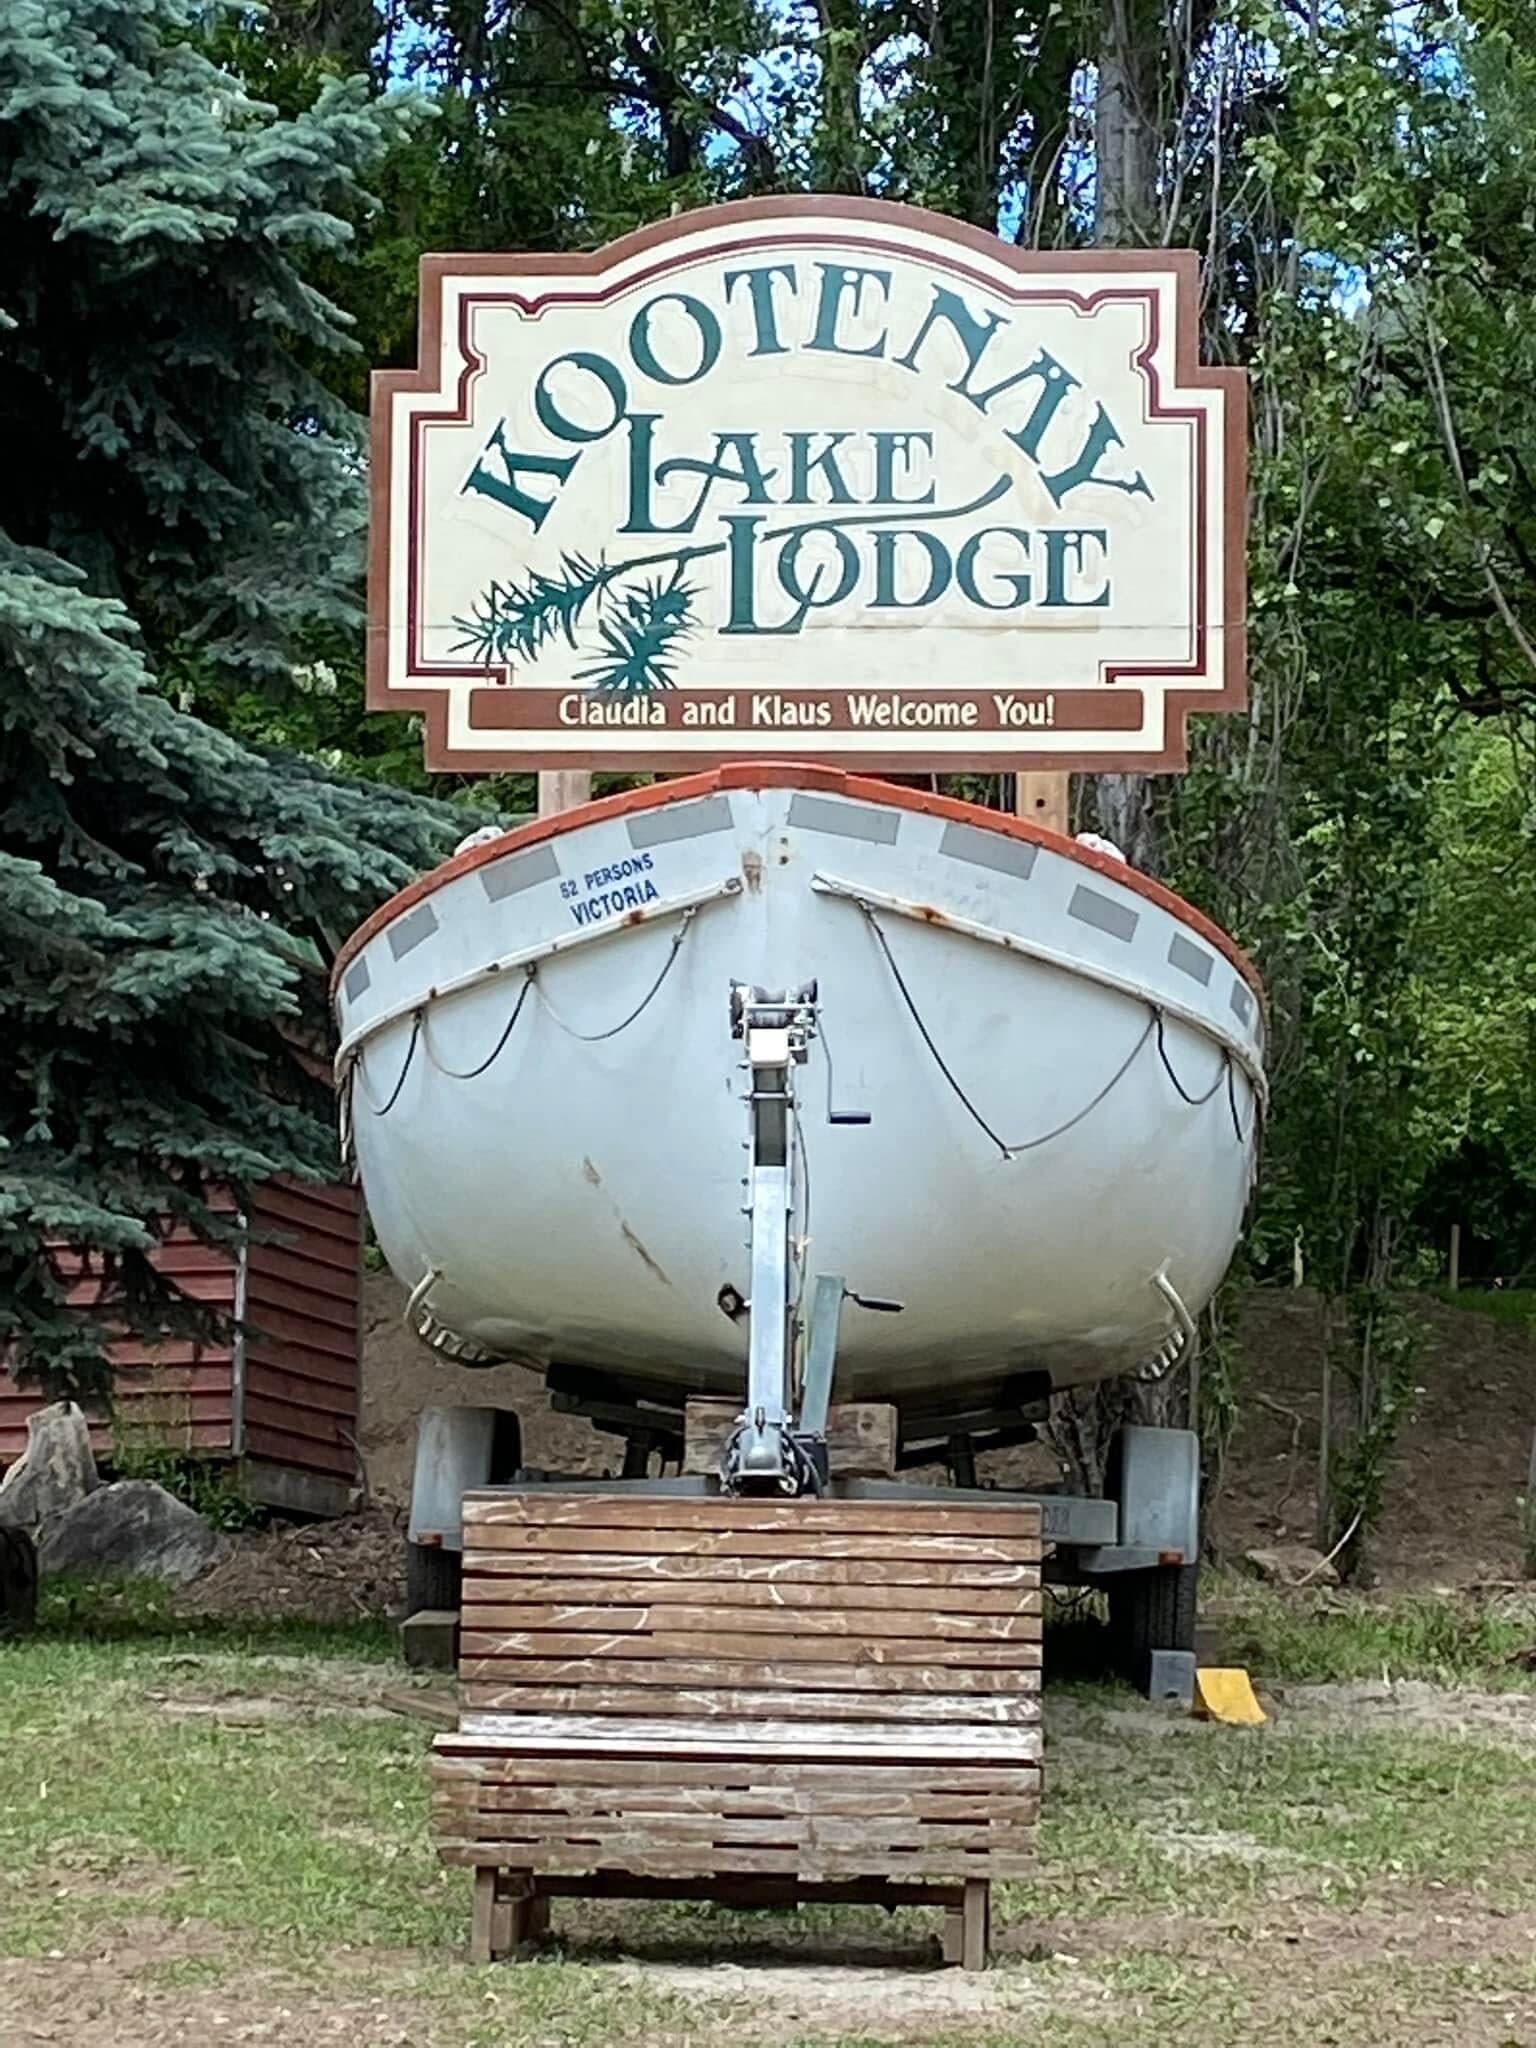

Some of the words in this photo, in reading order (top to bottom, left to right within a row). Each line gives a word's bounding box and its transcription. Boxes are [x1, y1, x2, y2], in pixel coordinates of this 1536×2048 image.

[460, 262, 1153, 533] KOOTENAY
[617, 413, 936, 534] LAKE
[718, 514, 1111, 635] LODGE
[559, 694, 666, 725] Claudia
[682, 696, 735, 725] and
[752, 695, 832, 725] Klaus
[848, 694, 978, 725] Welcome
[993, 694, 1055, 725] You!
[570, 880, 659, 925] VICTORIA
[584, 853, 654, 890] PERSONS
